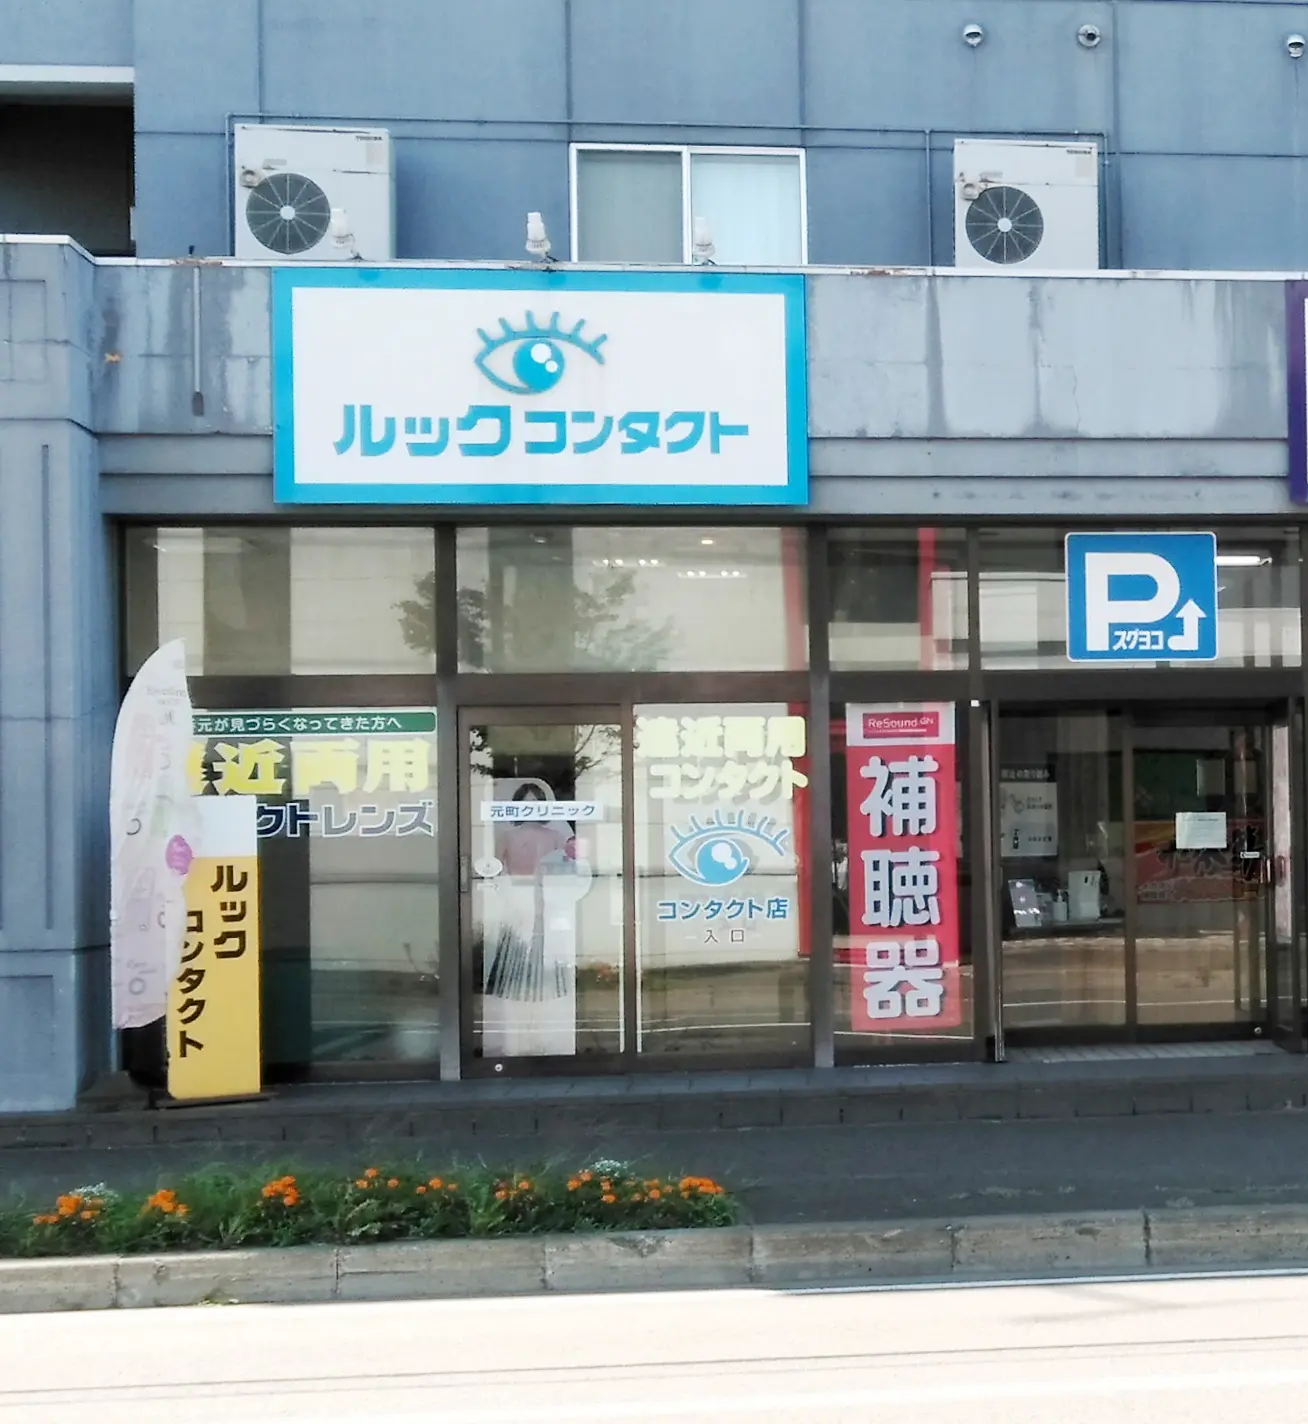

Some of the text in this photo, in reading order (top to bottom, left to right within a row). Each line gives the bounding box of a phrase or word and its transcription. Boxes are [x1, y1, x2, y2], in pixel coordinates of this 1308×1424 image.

[1085, 552, 1181, 652] P
[1112, 628, 1164, 651] スグヨコ
[868, 718, 918, 729] ReSound
[650, 758, 808, 800] コンタクト
[490, 804, 596, 818] 元町クリニック
[859, 755, 944, 1019] 補聴器
[210, 865, 248, 960] ルック
[657, 897, 789, 921] コンタクト店
[703, 929, 745, 944] 入口
[176, 909, 207, 1058] コンタクト
